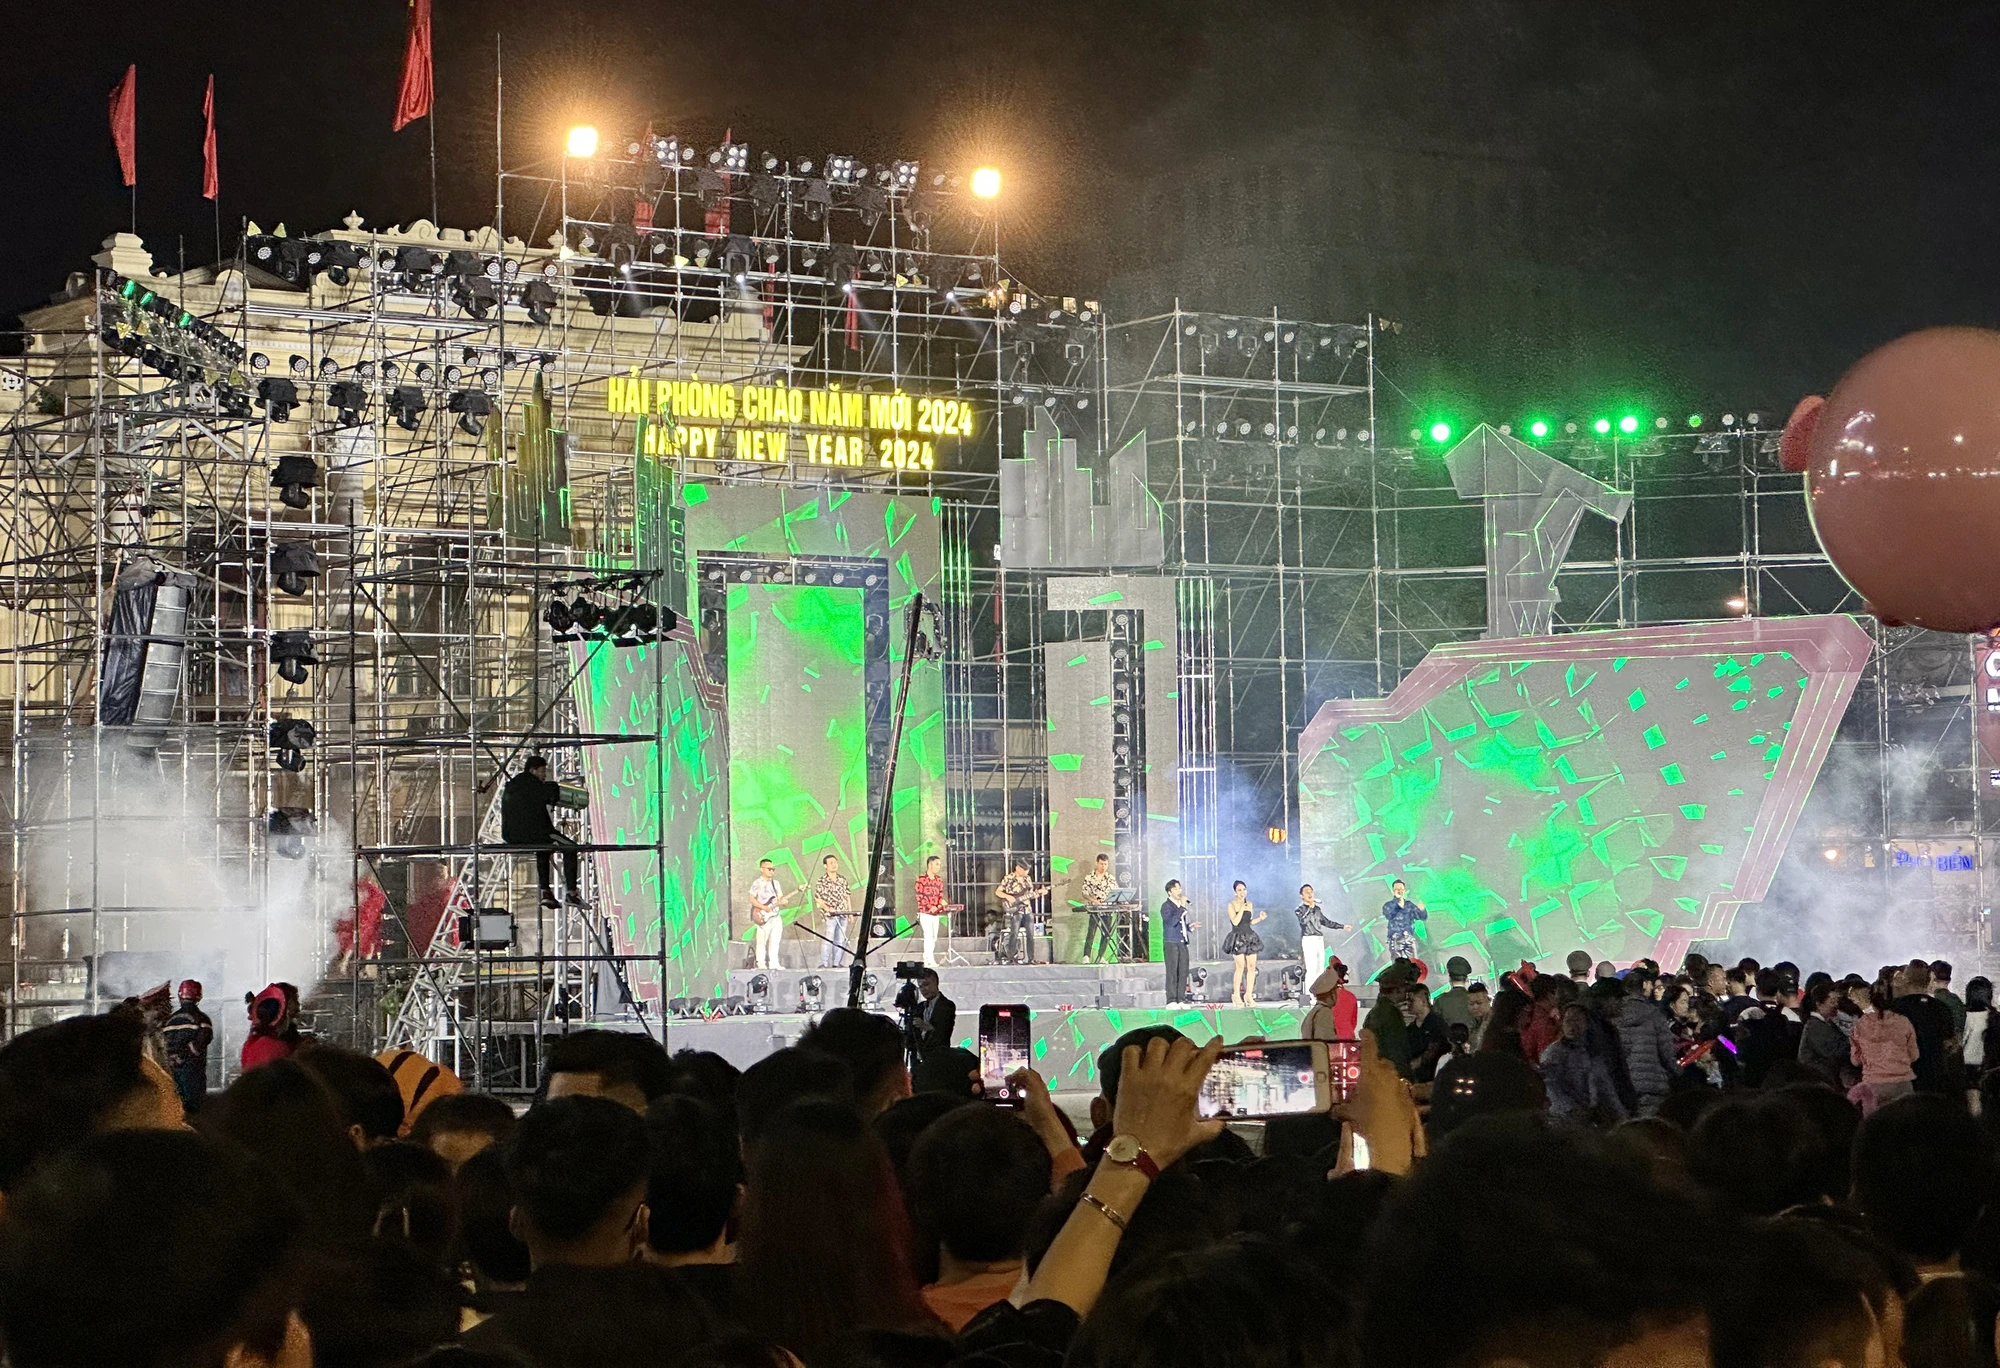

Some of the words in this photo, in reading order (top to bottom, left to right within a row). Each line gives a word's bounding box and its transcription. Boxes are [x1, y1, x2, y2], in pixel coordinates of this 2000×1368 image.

[608, 365, 649, 414] HẢI
[657, 373, 735, 419] PHÒNG
[742, 380, 803, 423] CHÀO
[809, 383, 863, 427] NĂM
[869, 388, 912, 431] MỚI
[917, 398, 973, 436] 2024
[644, 424, 718, 458] HAPPY
[736, 429, 787, 462] NEW
[805, 433, 863, 466] YEAR
[880, 438, 933, 471] 2024
